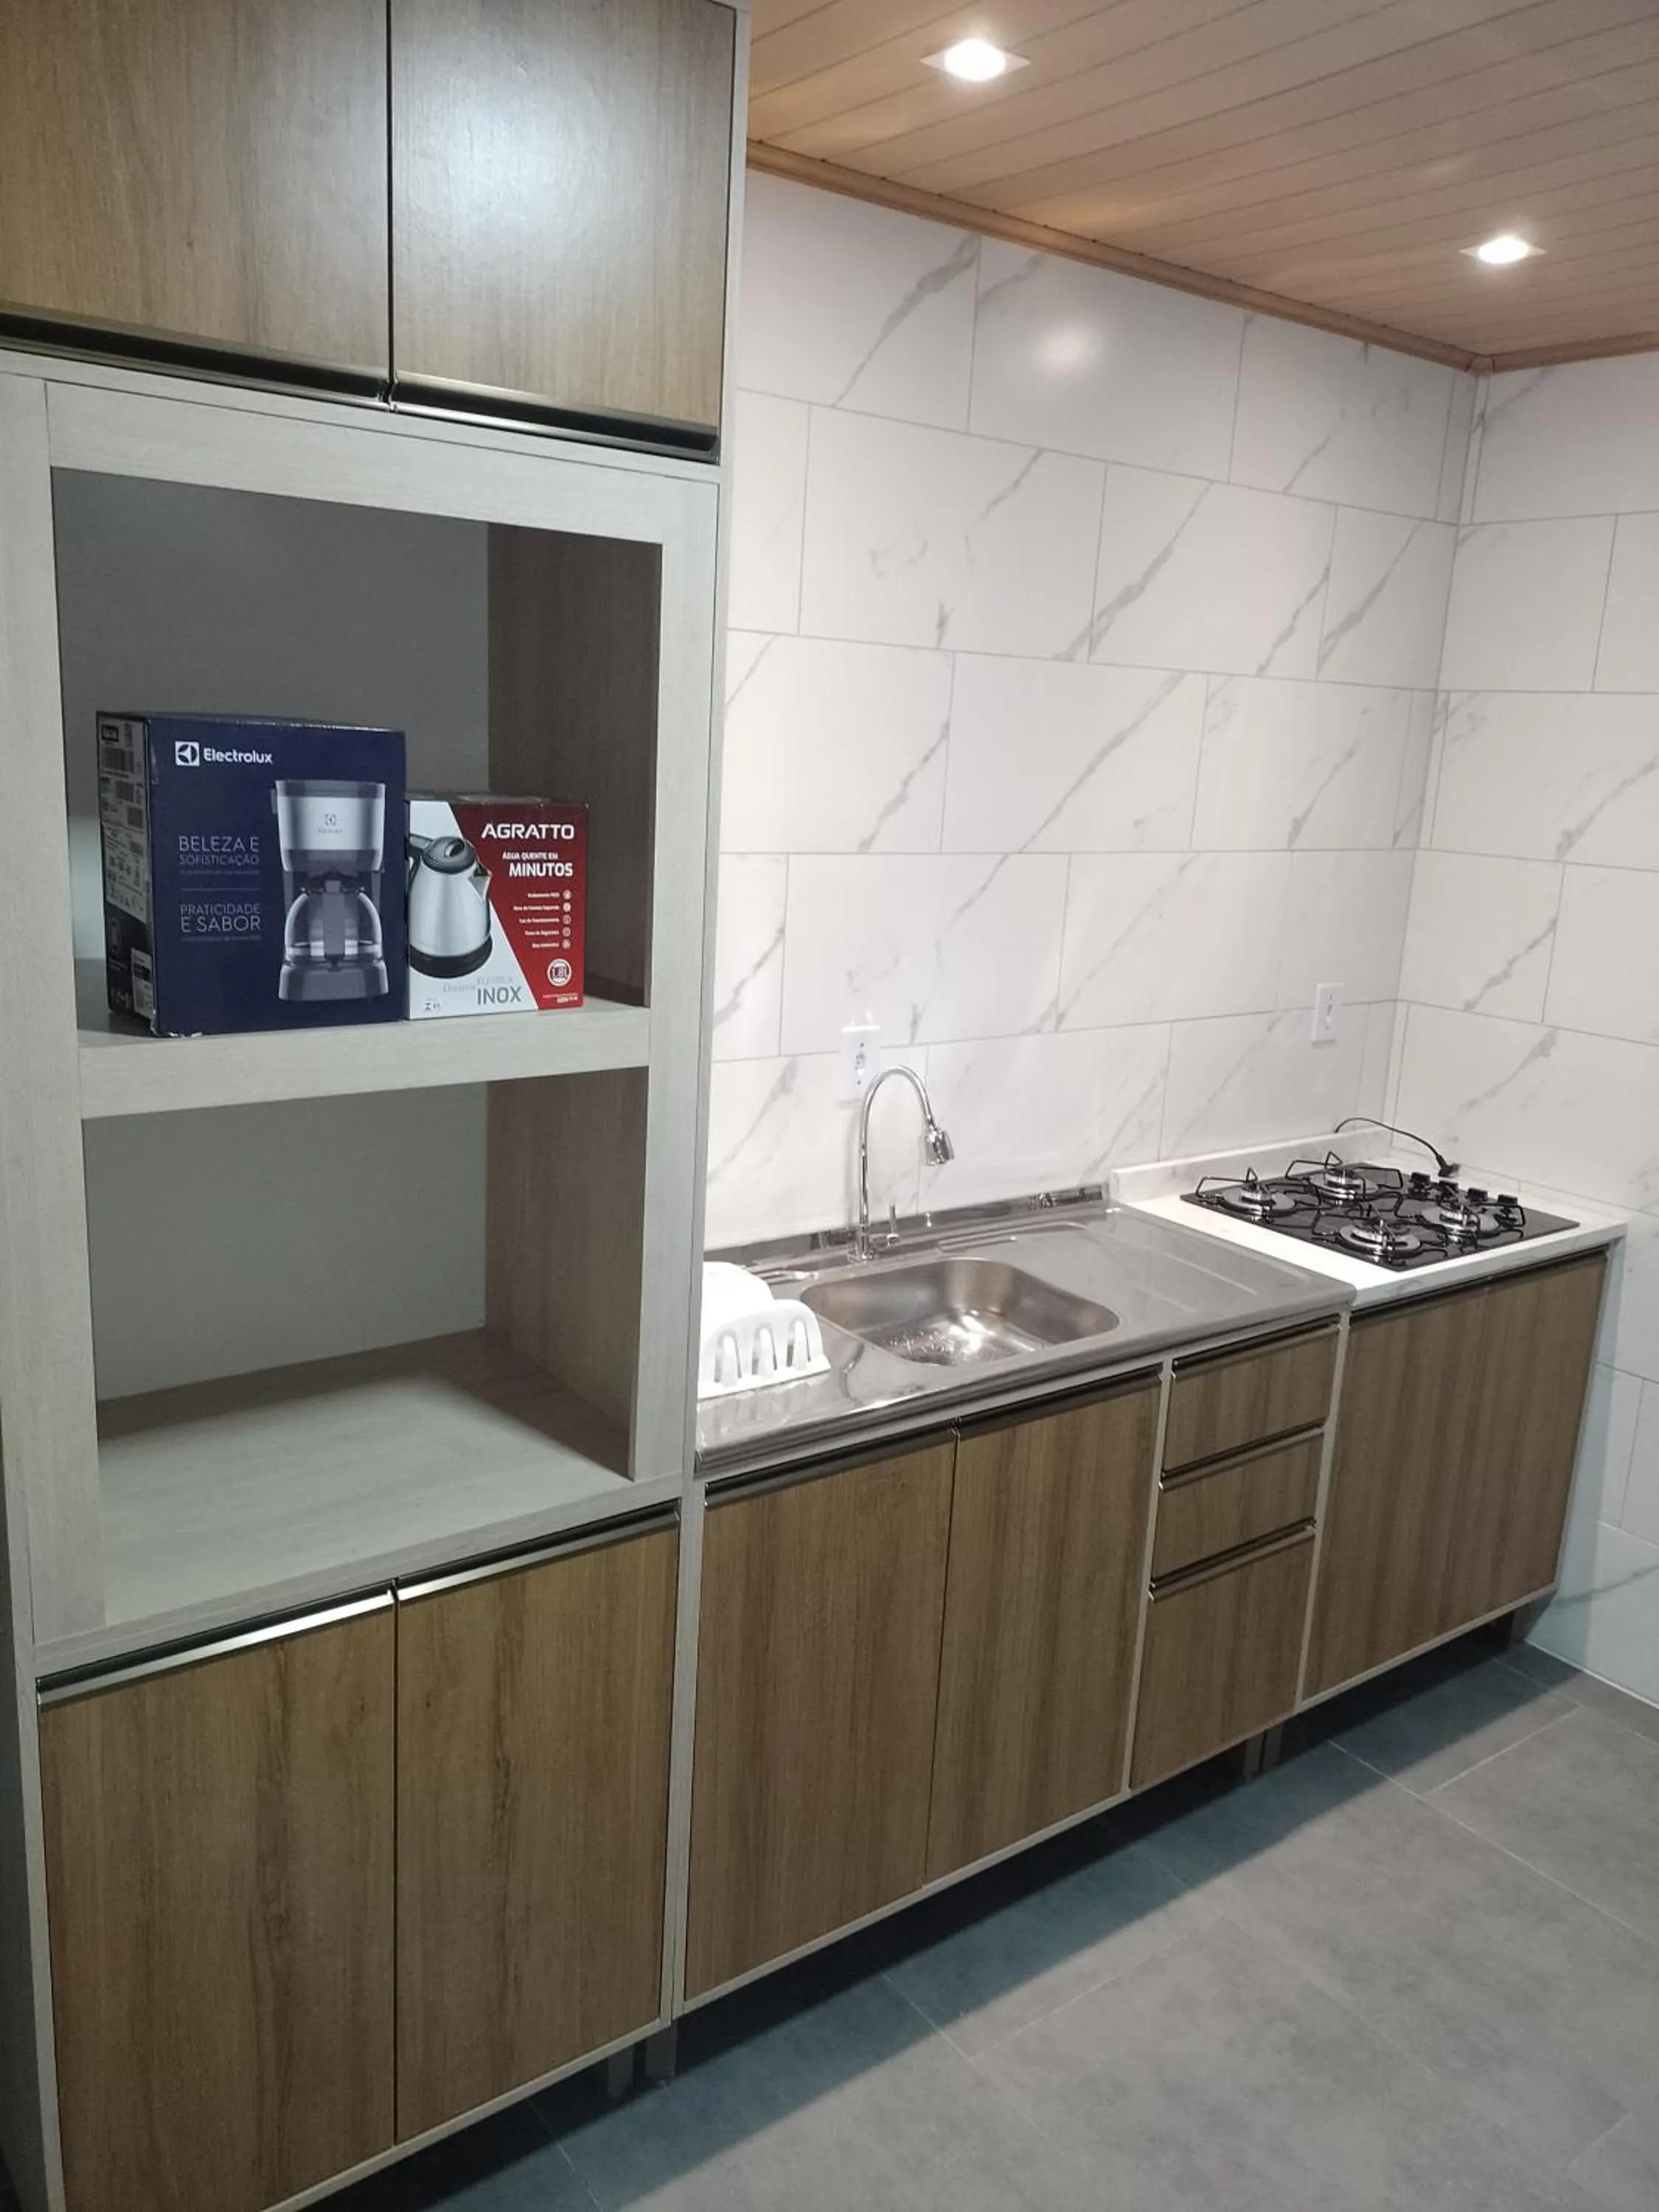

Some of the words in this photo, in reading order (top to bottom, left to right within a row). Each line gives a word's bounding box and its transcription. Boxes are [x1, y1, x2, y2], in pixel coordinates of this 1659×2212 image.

[204, 748, 272, 764] Electrolux
[481, 824, 574, 840] AGRATTO
[178, 835, 246, 852] BELEZA
[250, 837, 260, 852] E
[179, 855, 260, 866] SOFISTICAÇÃO
[509, 863, 573, 877] MINUTOS
[180, 903, 260, 915] PRATICIDADE
[181, 917, 191, 932] E
[197, 916, 260, 932] SABOR
[477, 987, 521, 1005] INOX
